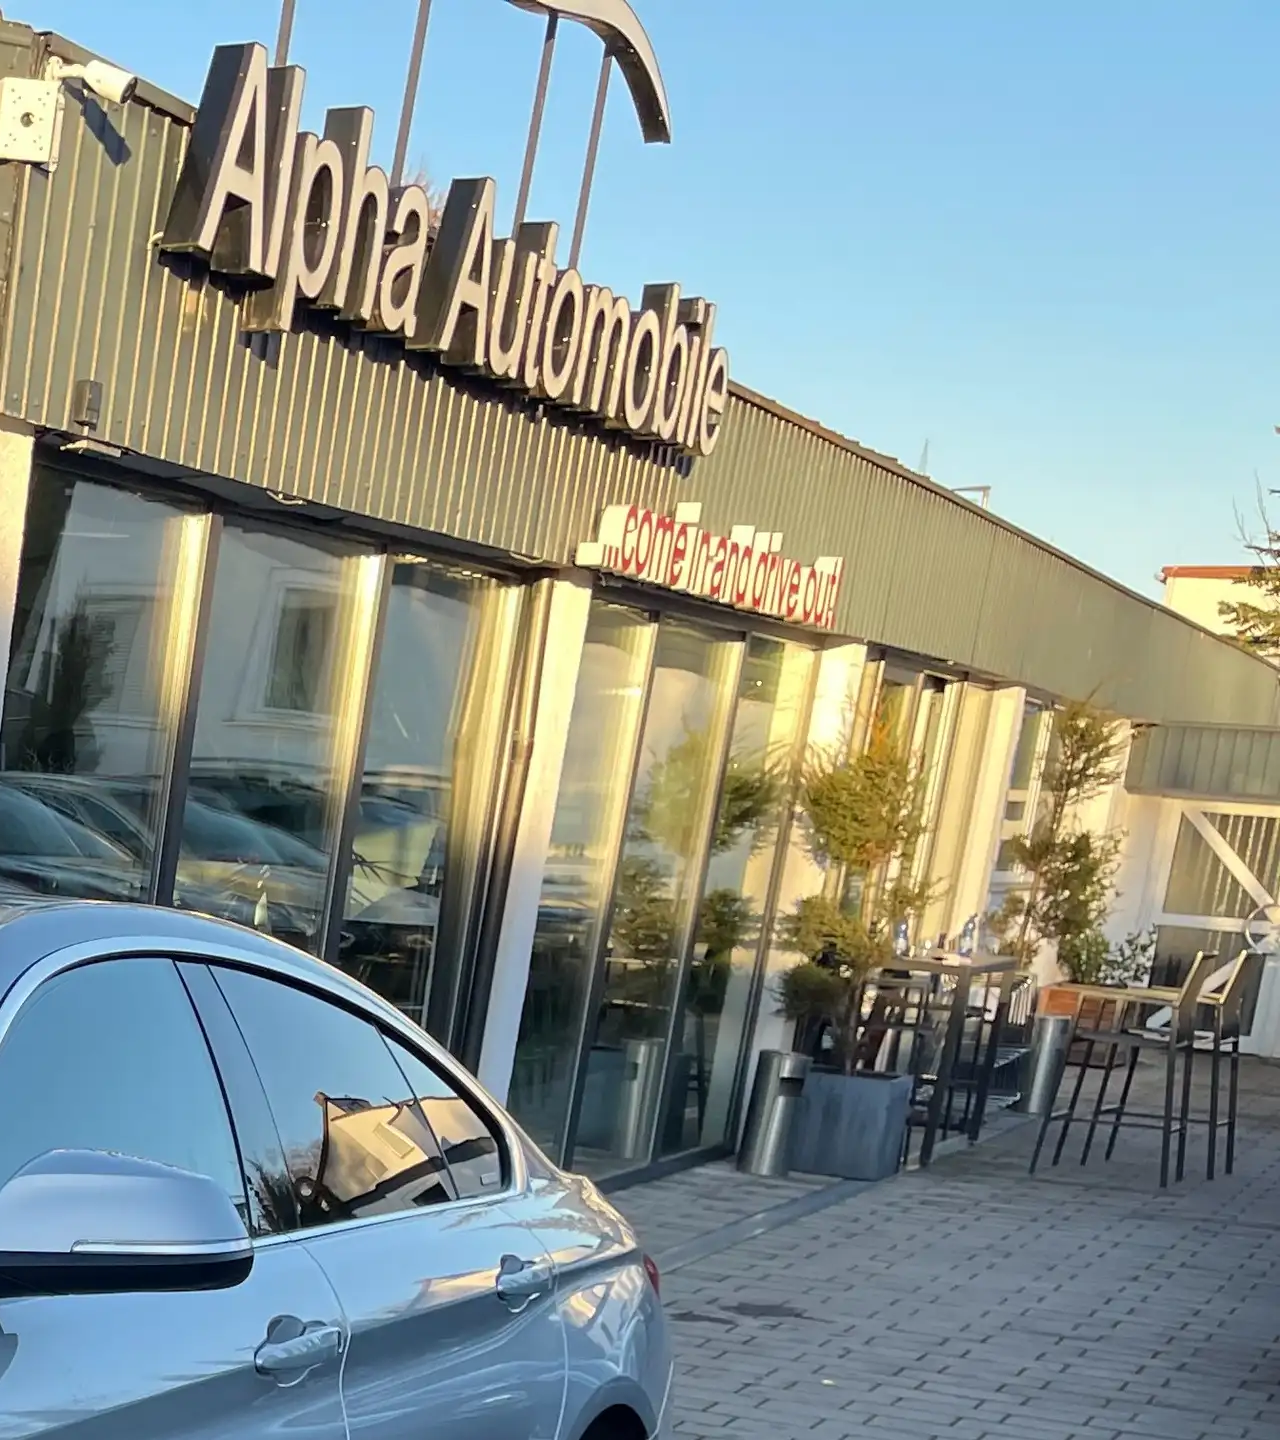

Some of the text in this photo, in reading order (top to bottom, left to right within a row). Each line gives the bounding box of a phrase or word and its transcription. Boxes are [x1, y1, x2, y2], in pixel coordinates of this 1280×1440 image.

[168, 42, 730, 457] Alpha Automobile
[752, 533, 802, 620] drive
[802, 557, 845, 629] out!
